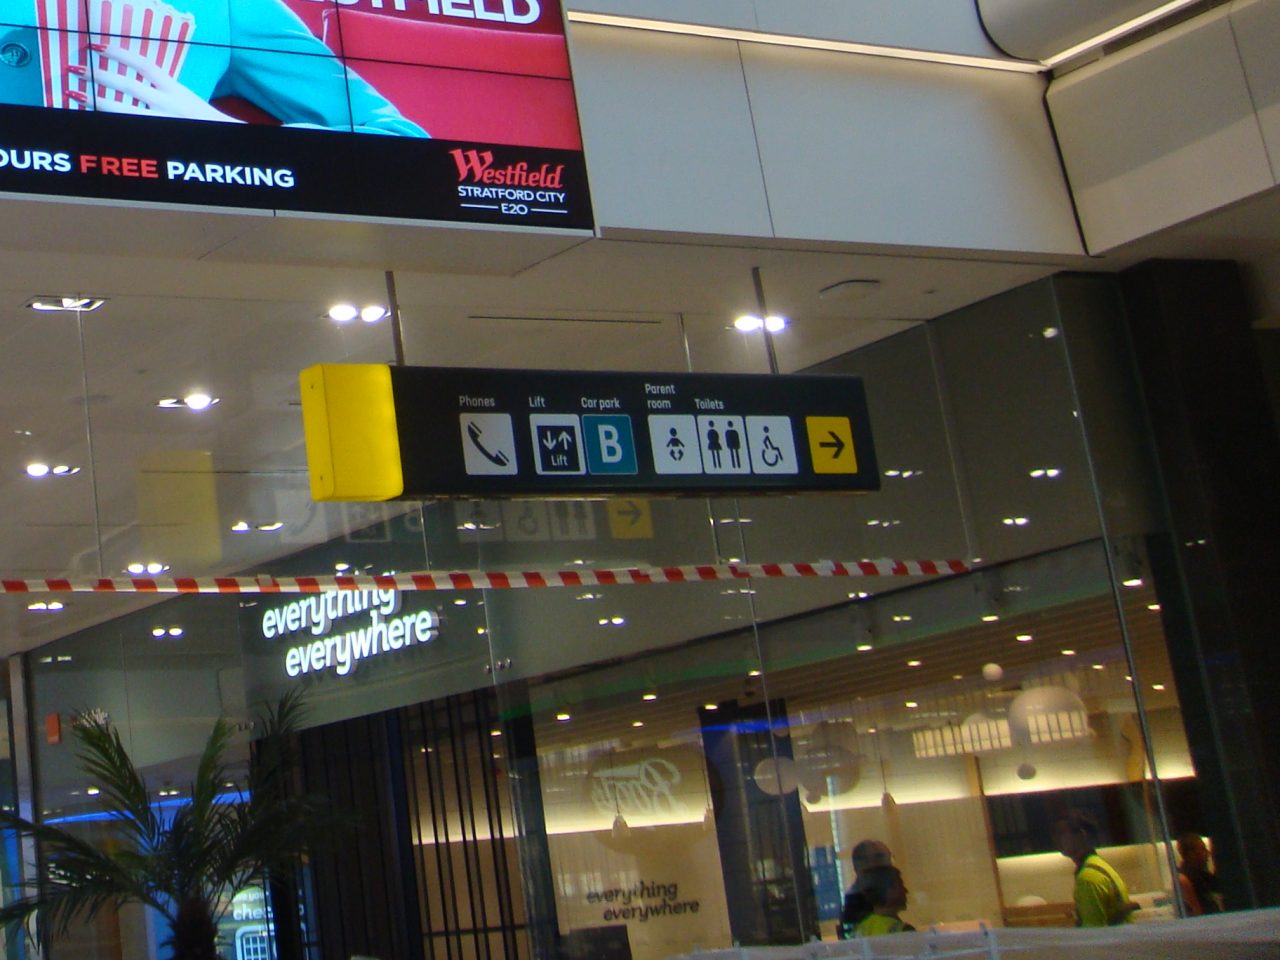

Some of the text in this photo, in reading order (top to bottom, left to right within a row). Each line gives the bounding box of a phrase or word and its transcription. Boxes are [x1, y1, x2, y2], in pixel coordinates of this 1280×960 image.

[79, 155, 159, 179] FREE
[167, 161, 295, 188] PARKING
[448, 148, 565, 189] Westfield
[458, 186, 566, 203] STRATFORD CITY
[501, 203, 528, 215] E20
[645, 383, 675, 396] Parent
[458, 395, 495, 408] Phones
[528, 396, 546, 408] Lift
[581, 397, 620, 410] Car park
[647, 399, 672, 410] room
[694, 398, 724, 410] Toilets
[598, 424, 623, 464] B
[551, 454, 568, 467] Lift
[262, 580, 397, 639] everything
[285, 609, 433, 677] everywhere
[586, 880, 678, 904] everything
[603, 898, 700, 922] everywhere
